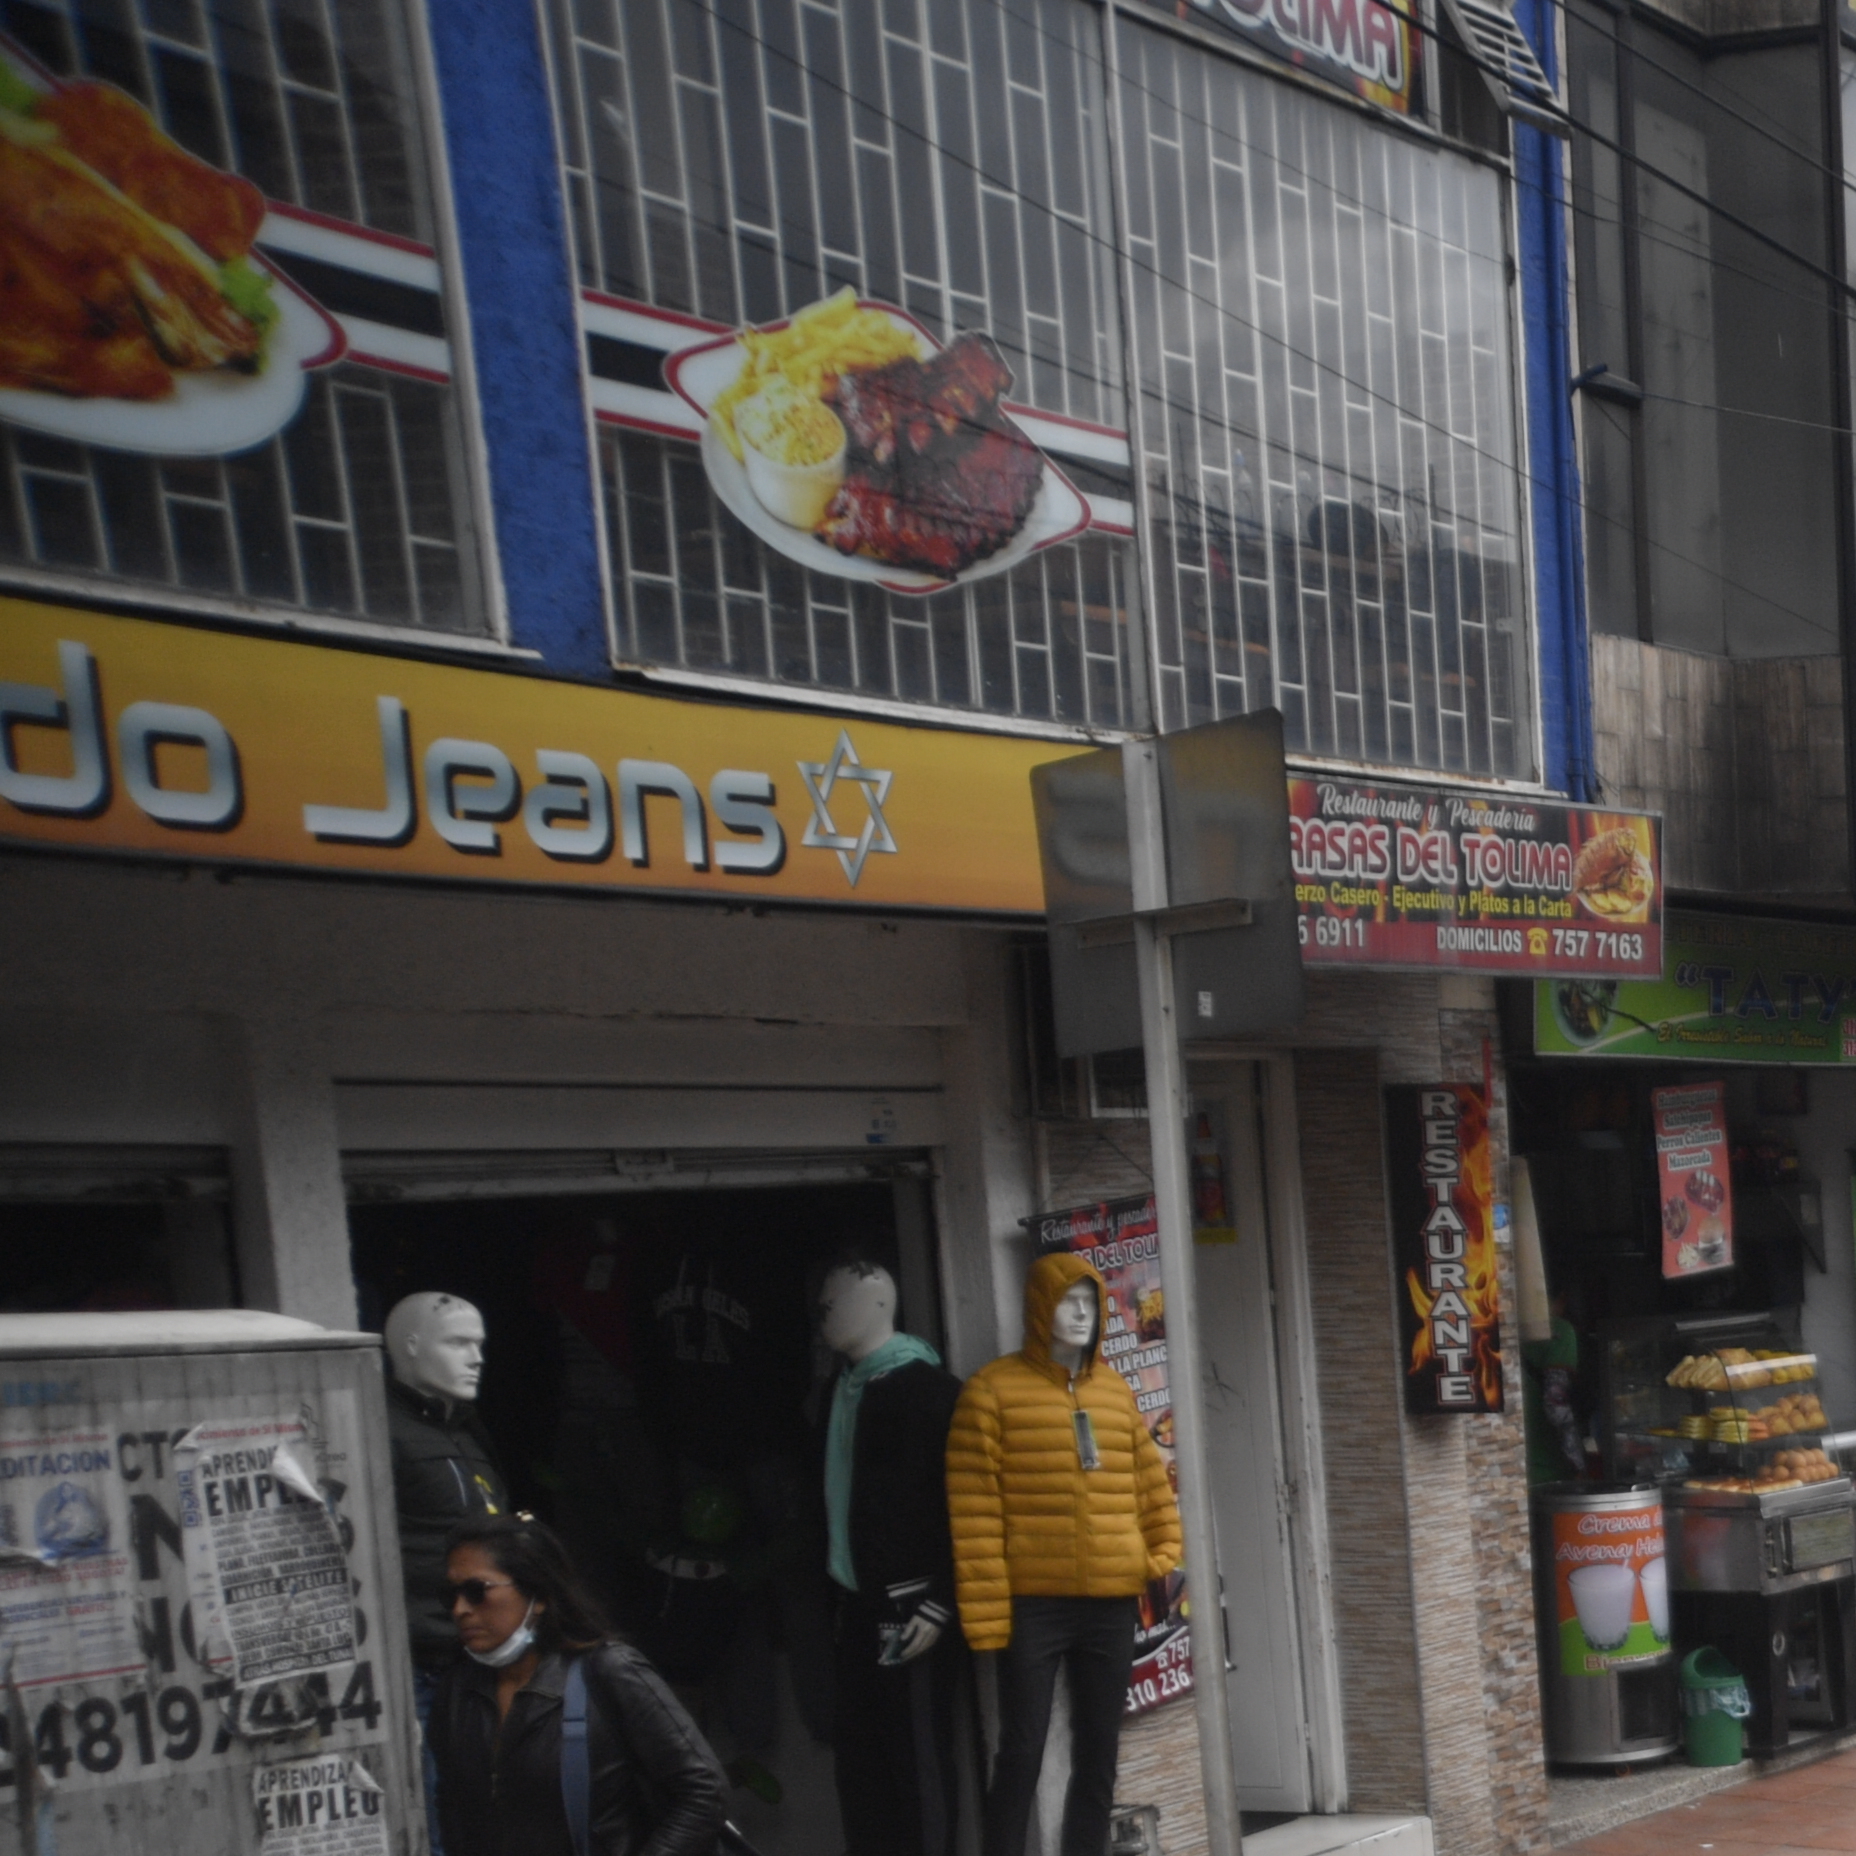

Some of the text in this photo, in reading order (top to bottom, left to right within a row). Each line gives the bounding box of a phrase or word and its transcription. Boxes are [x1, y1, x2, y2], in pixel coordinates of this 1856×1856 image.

[302, 694, 787, 876] Jeans
[1316, 782, 1537, 833] Restaurante y Pescadería
[1397, 825, 1459, 886] DEL
[1460, 832, 1574, 892] TOLIMA
[1330, 881, 1380, 906] Casero
[1392, 887, 1455, 913] Ejecutivo
[1457, 895, 1467, 917] y
[1468, 889, 1511, 914] Platos
[1511, 897, 1522, 915] a
[1523, 894, 1536, 916] la
[1537, 894, 1573, 918] Carta
[1314, 915, 1644, 960] 6911 DOMICILIOS 757 7163
[1656, 1129, 1722, 1151] Perros Calientes
[1040, 1212, 1117, 1245] Restaurante y
[1094, 1242, 1123, 1272] DEL
[1420, 1090, 1475, 1405] RESTAURANTE
[1101, 1332, 1138, 1358] CERDO
[1116, 1353, 1132, 1373] LA
[1577, 1513, 1652, 1536] Crema
[1555, 1542, 1632, 1561] Avena
[1168, 1634, 1192, 1664] 757
[1157, 1662, 1192, 1697] 236
